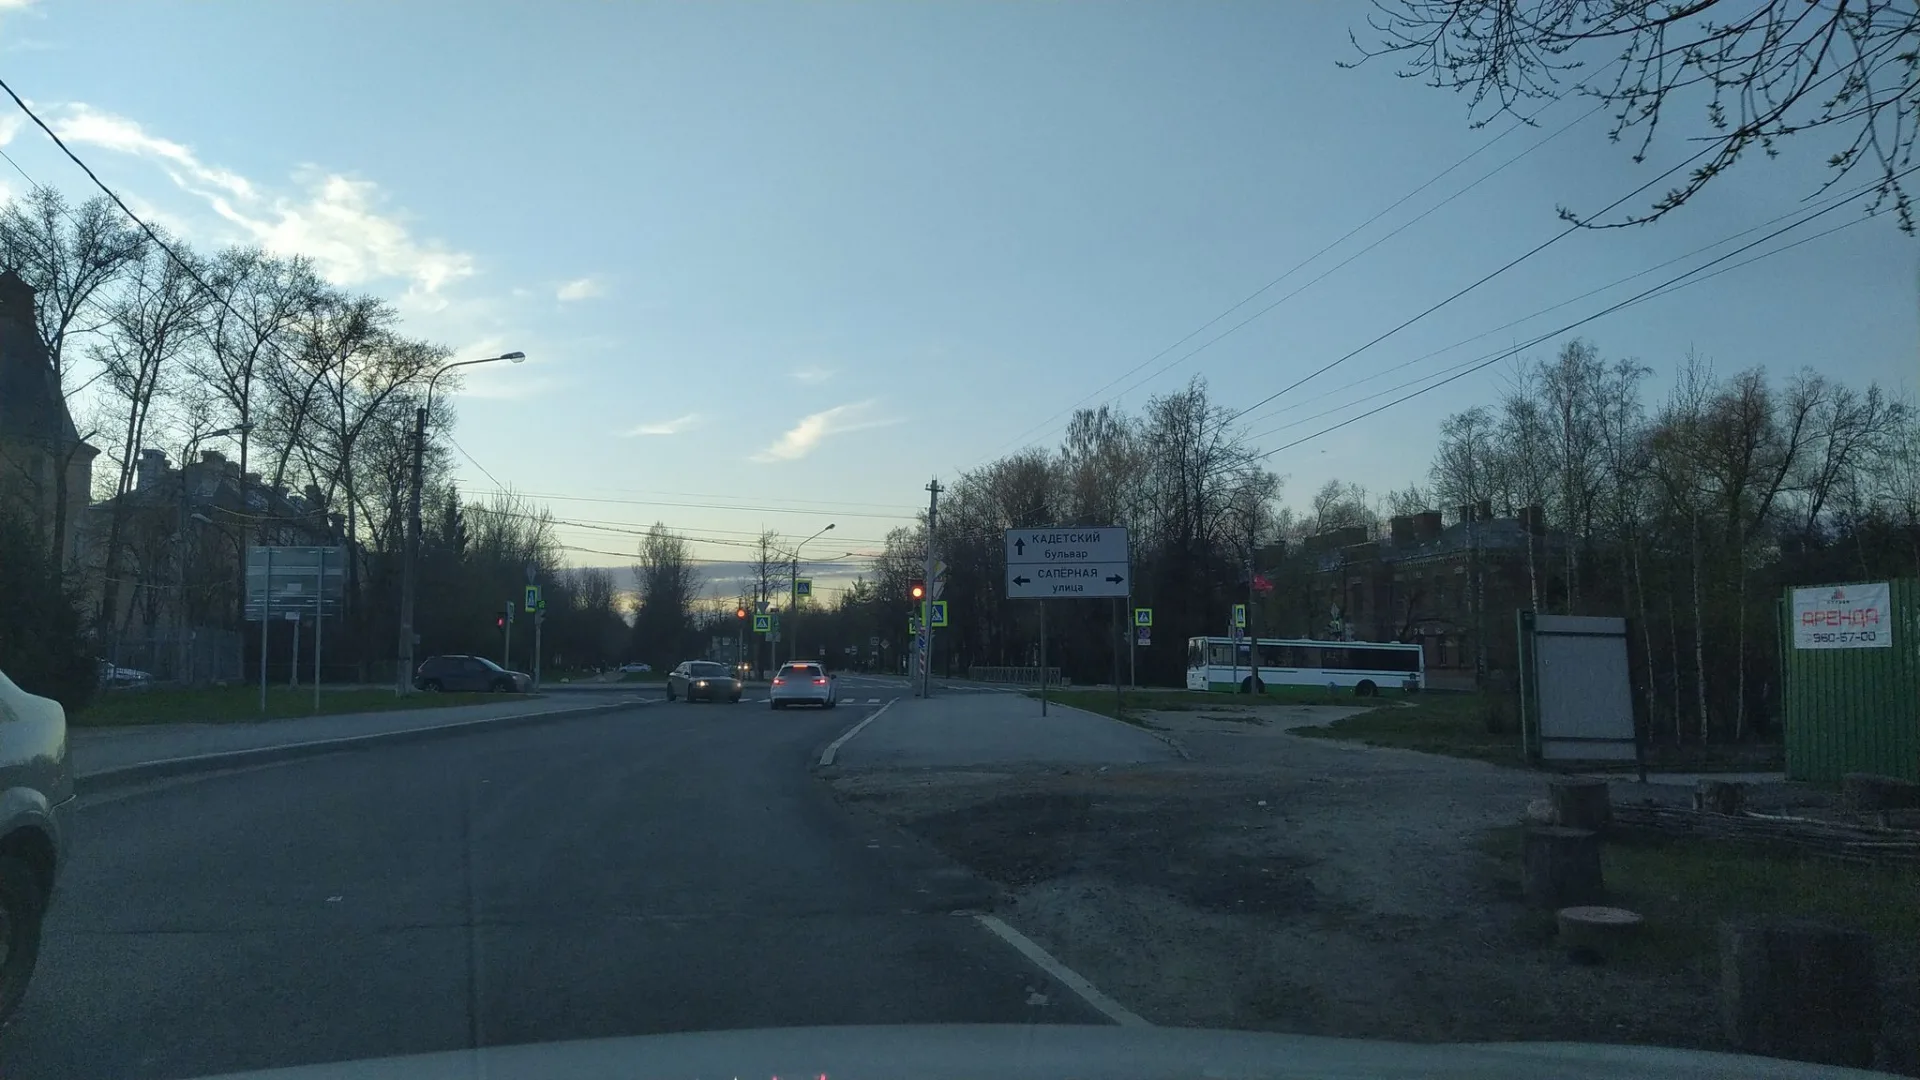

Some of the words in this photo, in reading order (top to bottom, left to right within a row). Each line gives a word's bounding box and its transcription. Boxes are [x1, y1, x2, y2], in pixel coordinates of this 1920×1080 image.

[1032, 532, 1100, 544] КАДЕТСКИЙ
[1045, 550, 1088, 560] бульвар
[1052, 584, 1083, 594] улица
[1802, 608, 1879, 627] АРЕНДА
